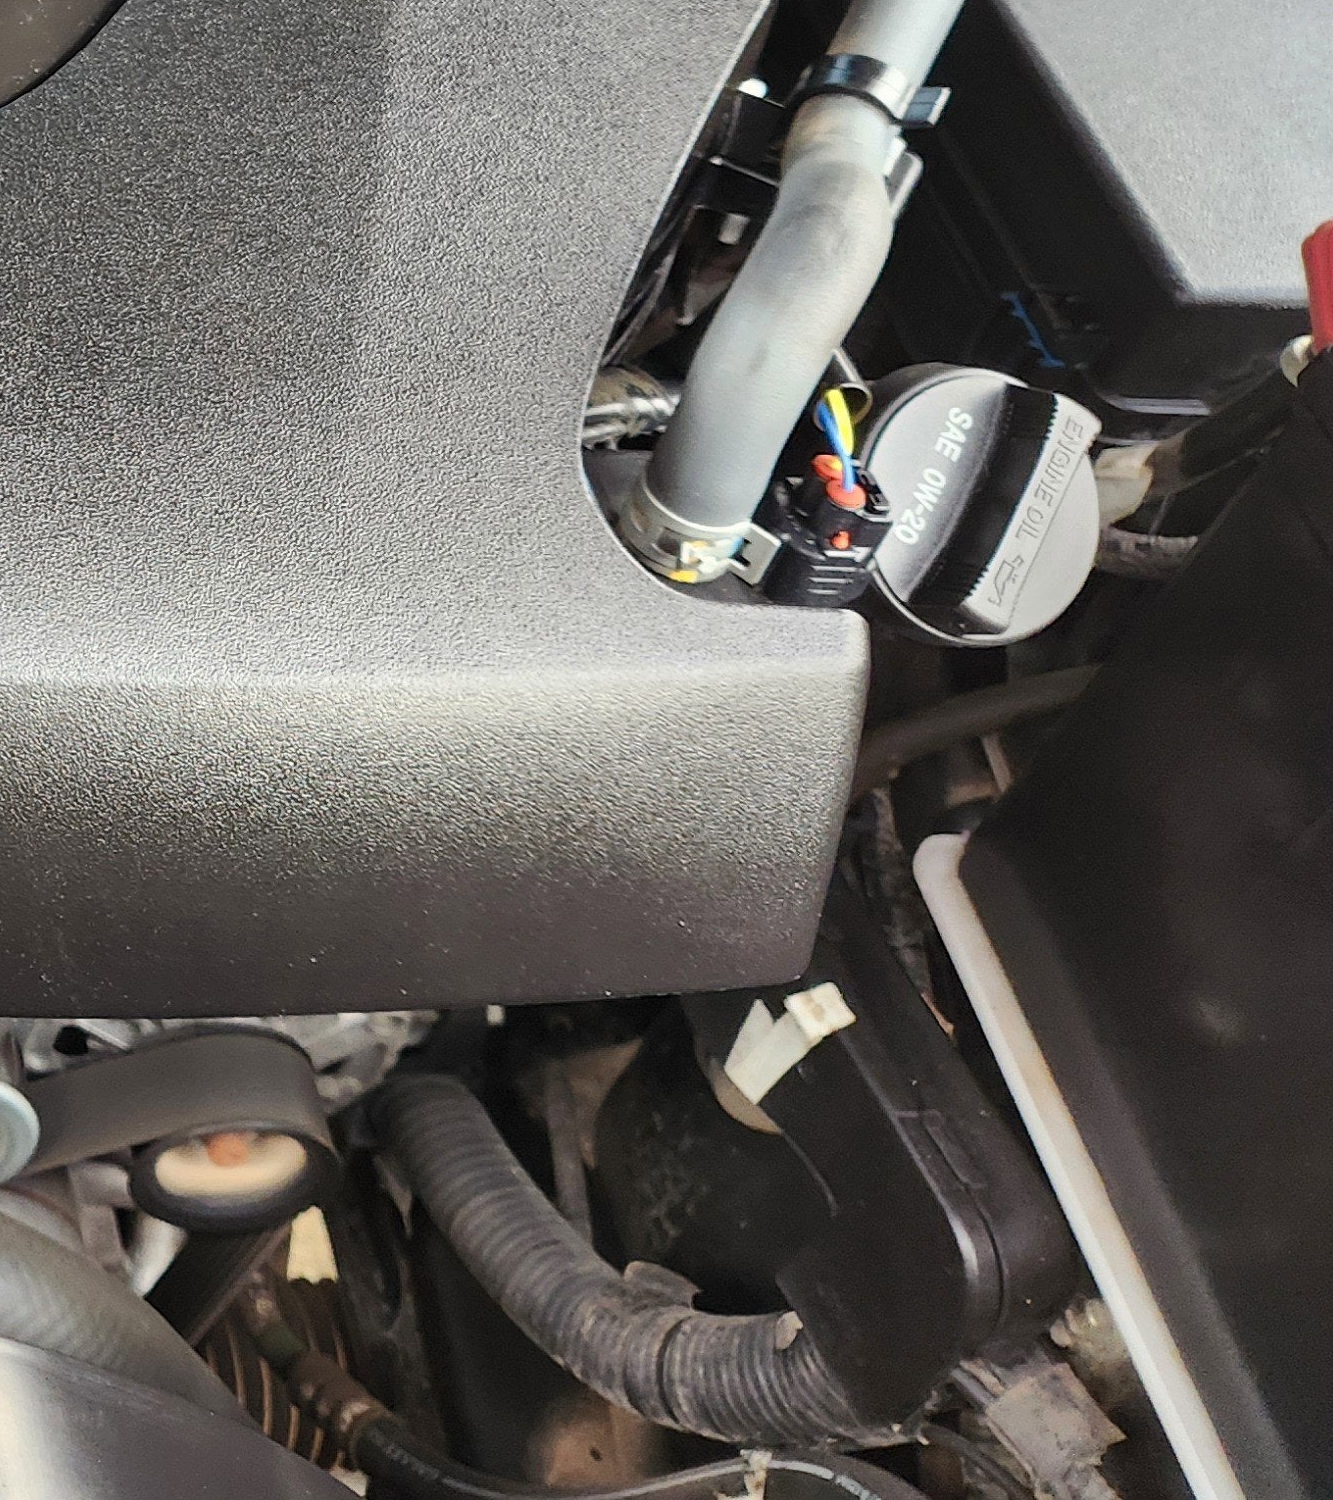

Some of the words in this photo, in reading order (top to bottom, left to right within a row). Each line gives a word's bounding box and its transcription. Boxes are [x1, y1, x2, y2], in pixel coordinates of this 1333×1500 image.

[935, 406, 973, 462] SAE
[1035, 416, 1084, 507] ENGINE
[894, 467, 947, 545] 0W-20
[1015, 505, 1044, 540] OIL
